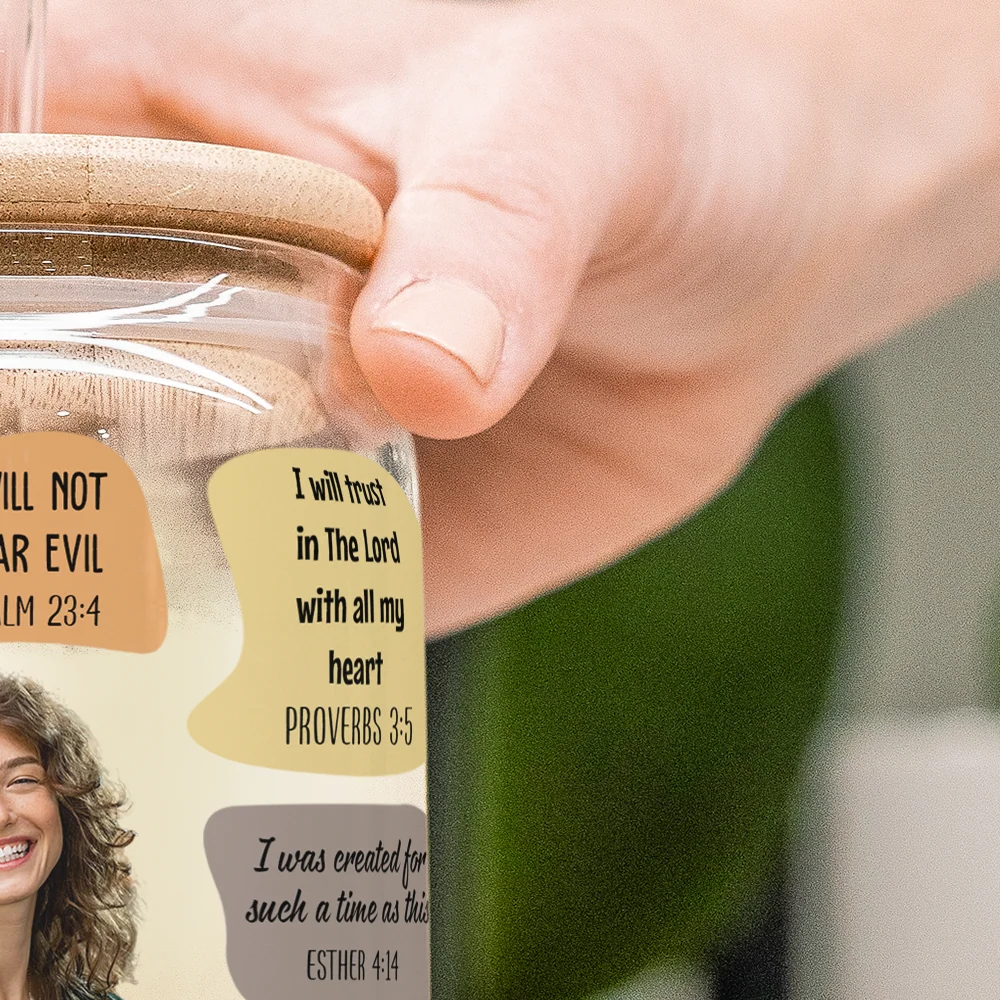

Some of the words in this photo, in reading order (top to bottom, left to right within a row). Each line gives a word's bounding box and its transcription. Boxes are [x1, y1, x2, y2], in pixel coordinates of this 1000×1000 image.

[51, 471, 108, 511] NOT
[291, 466, 306, 500] I
[308, 469, 344, 502] will
[344, 474, 387, 507] trust
[45, 533, 104, 574] EVIL
[296, 525, 319, 561] in
[324, 527, 360, 563] The
[362, 528, 401, 564] Lord
[47, 594, 101, 627] 23:4
[296, 587, 347, 624] with
[352, 588, 375, 624] all
[379, 596, 405, 633] my
[328, 649, 384, 686] heart
[285, 706, 382, 746] PROVERBS
[389, 706, 413, 746] 3:5
[253, 836, 276, 873] I
[277, 848, 326, 873] was
[333, 839, 402, 874] created
[401, 838, 427, 890] for
[245, 888, 308, 924] such
[315, 900, 331, 923] a
[336, 890, 378, 924] time
[381, 900, 400, 924] as
[306, 949, 366, 981] ESTHER
[371, 949, 399, 981] 4:14
